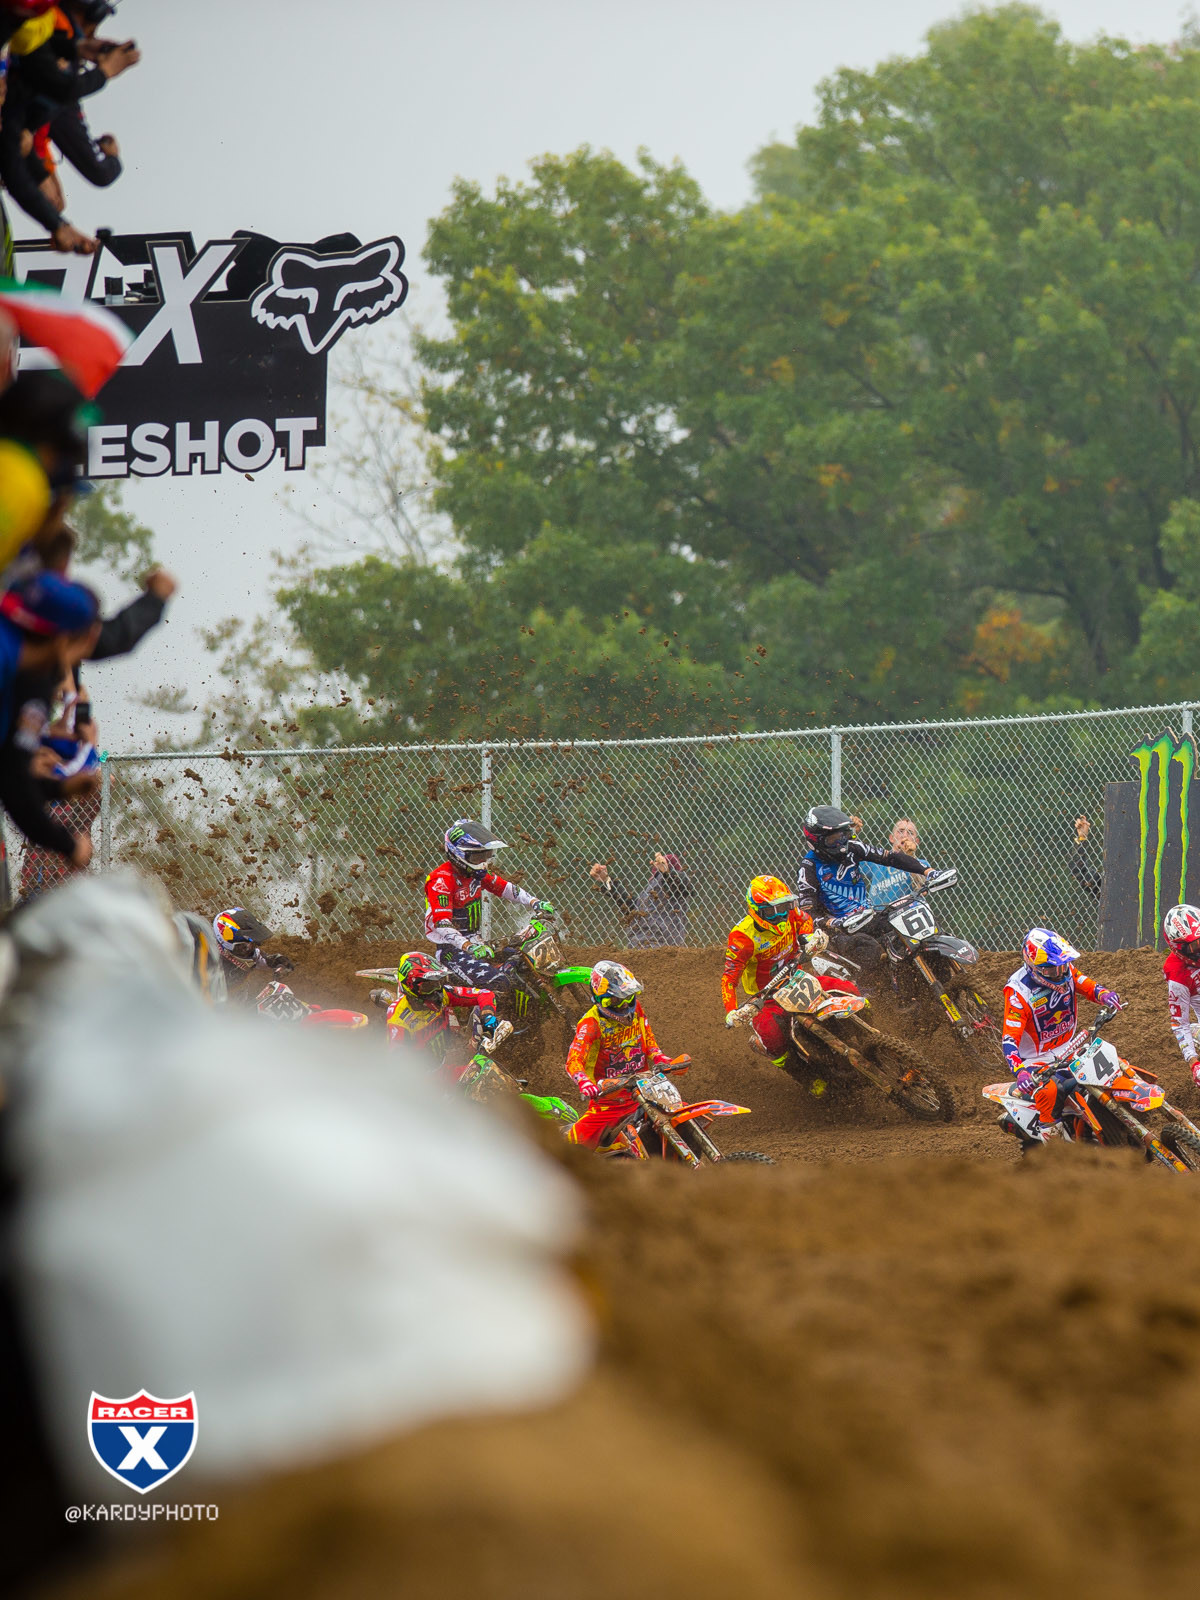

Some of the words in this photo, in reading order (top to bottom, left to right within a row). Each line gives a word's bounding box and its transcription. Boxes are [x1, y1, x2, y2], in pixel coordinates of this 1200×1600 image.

[76, 416, 318, 477] ESHOT
[902, 907, 934, 936] 61
[788, 977, 821, 1011] 52
[1041, 1023, 1060, 1040] Red
[1092, 1050, 1116, 1081] 4
